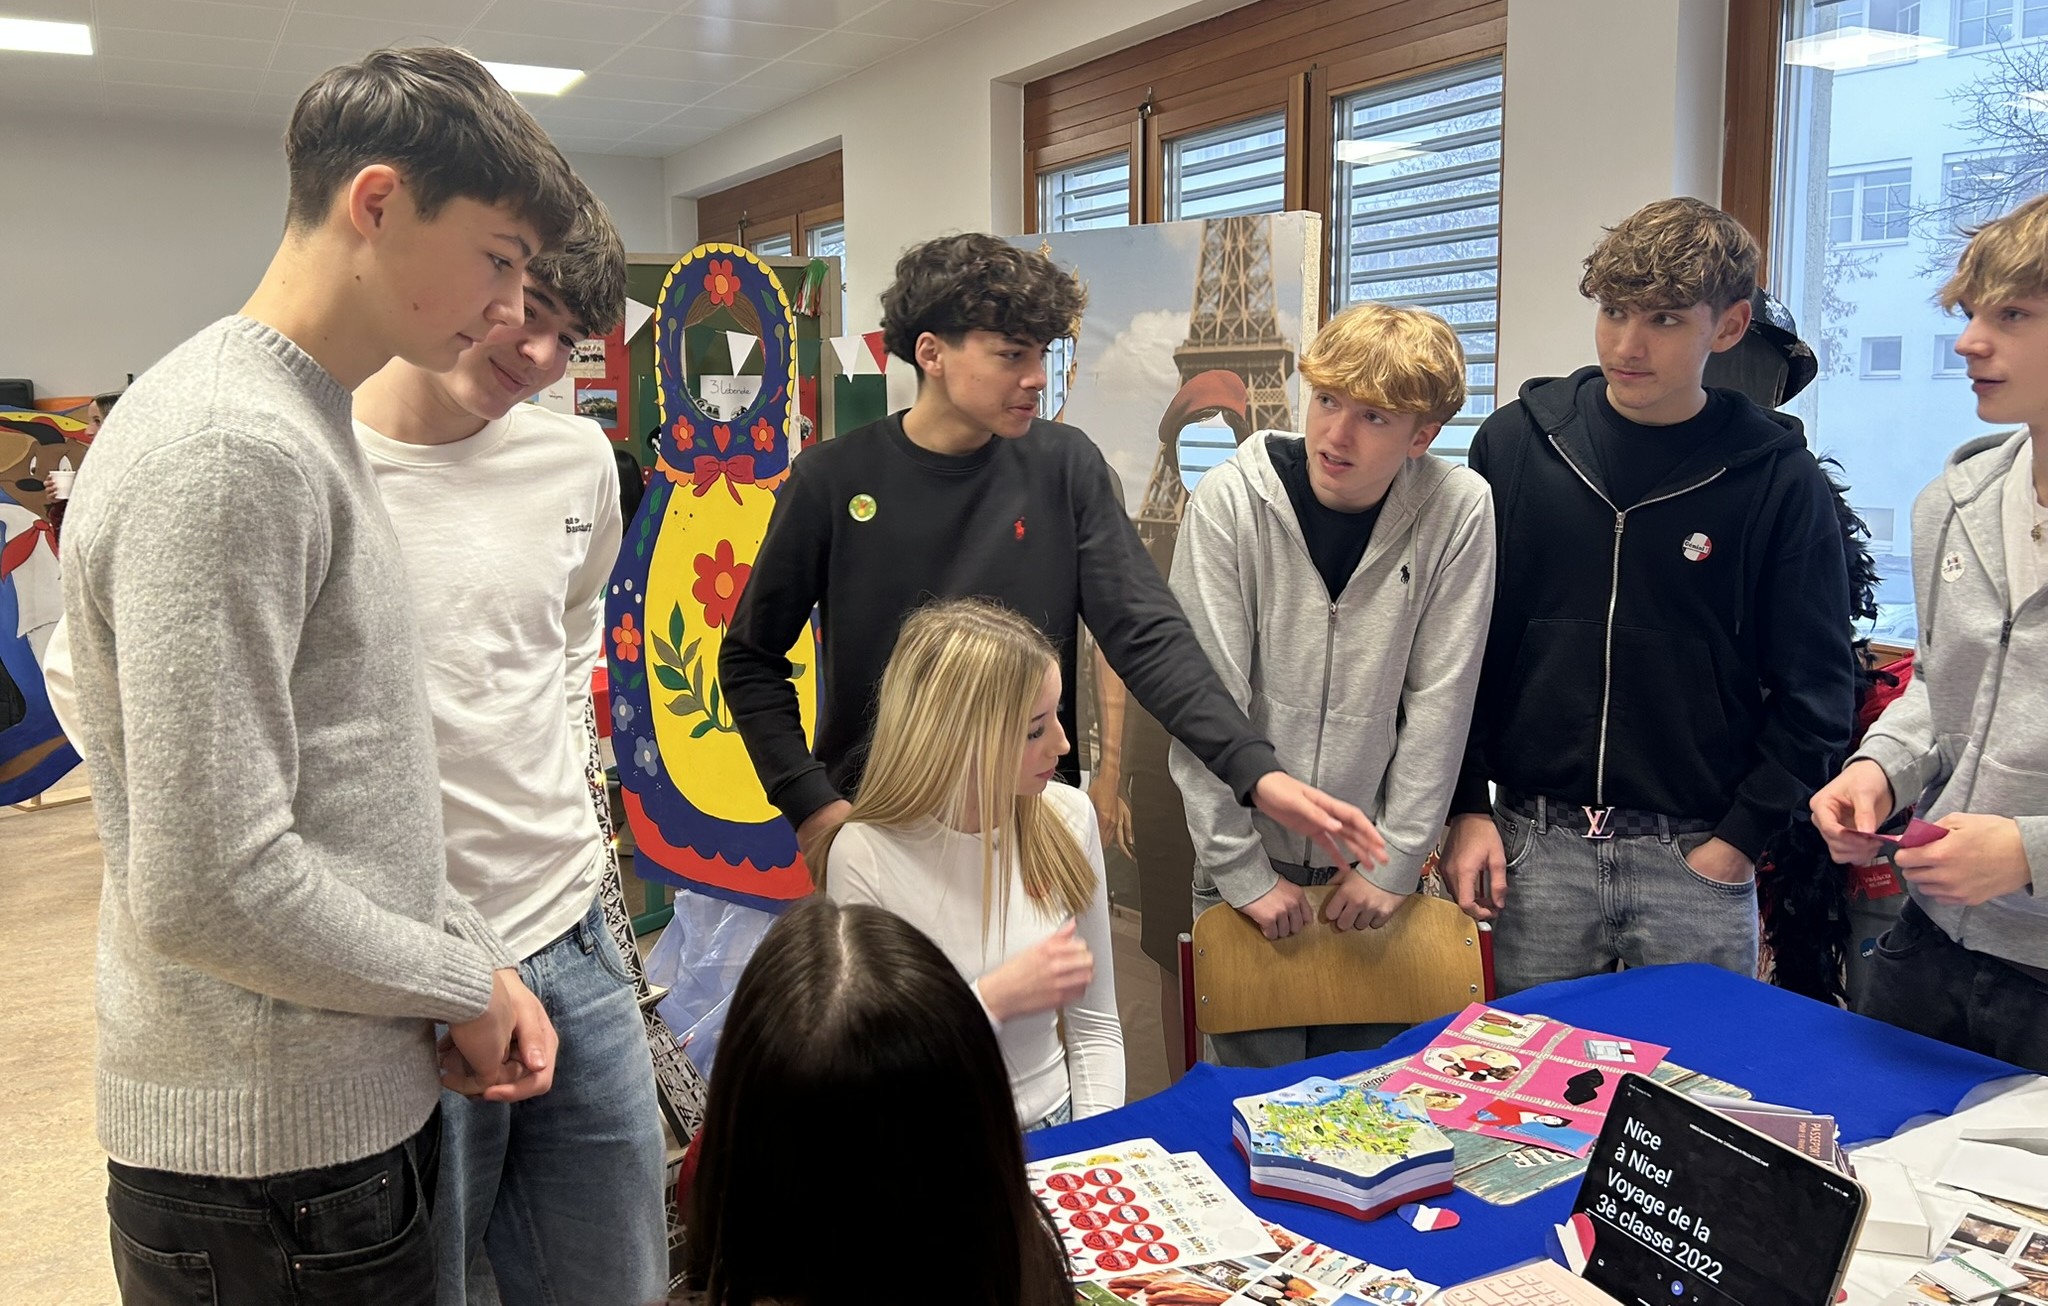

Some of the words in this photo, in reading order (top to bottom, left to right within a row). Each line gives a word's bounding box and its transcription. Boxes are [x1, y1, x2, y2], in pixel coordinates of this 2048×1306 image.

[1623, 1116, 1662, 1151] Nice
[1809, 1122, 1822, 1158] PASSEPORT
[1614, 1141, 1625, 1163] à
[1628, 1150, 1673, 1188] Nice!
[1607, 1167, 1666, 1216] Voyage
[1667, 1206, 1691, 1231] de
[1692, 1217, 1711, 1243] la
[1596, 1193, 1617, 1220] 3è
[1618, 1210, 1674, 1254] classe
[1674, 1241, 1724, 1285] 2022
